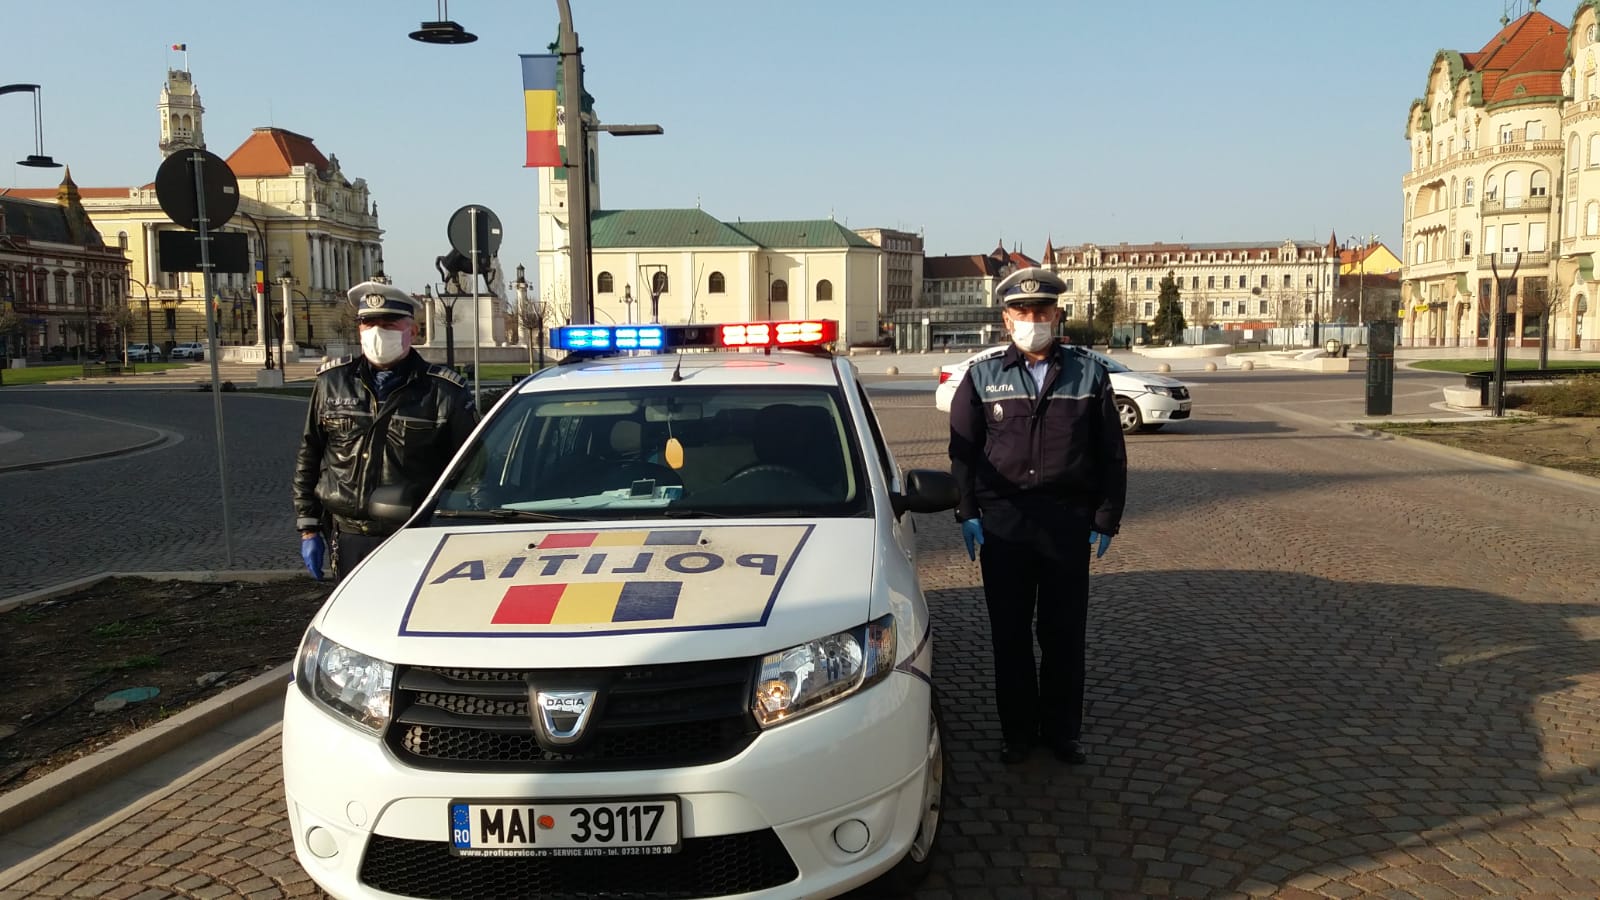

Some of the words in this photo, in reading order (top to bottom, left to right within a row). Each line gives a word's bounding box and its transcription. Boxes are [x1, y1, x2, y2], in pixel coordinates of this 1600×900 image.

[985, 384, 1014, 392] POLITIA
[546, 698, 585, 706] DACIA
[480, 808, 536, 844] MAI
[569, 805, 665, 843] 39117
[453, 829, 469, 843] RO
[553, 849, 581, 857] SERVICE
[584, 848, 602, 856] AUTO
[642, 847, 650, 855] 10
[662, 846, 672, 854] 30
